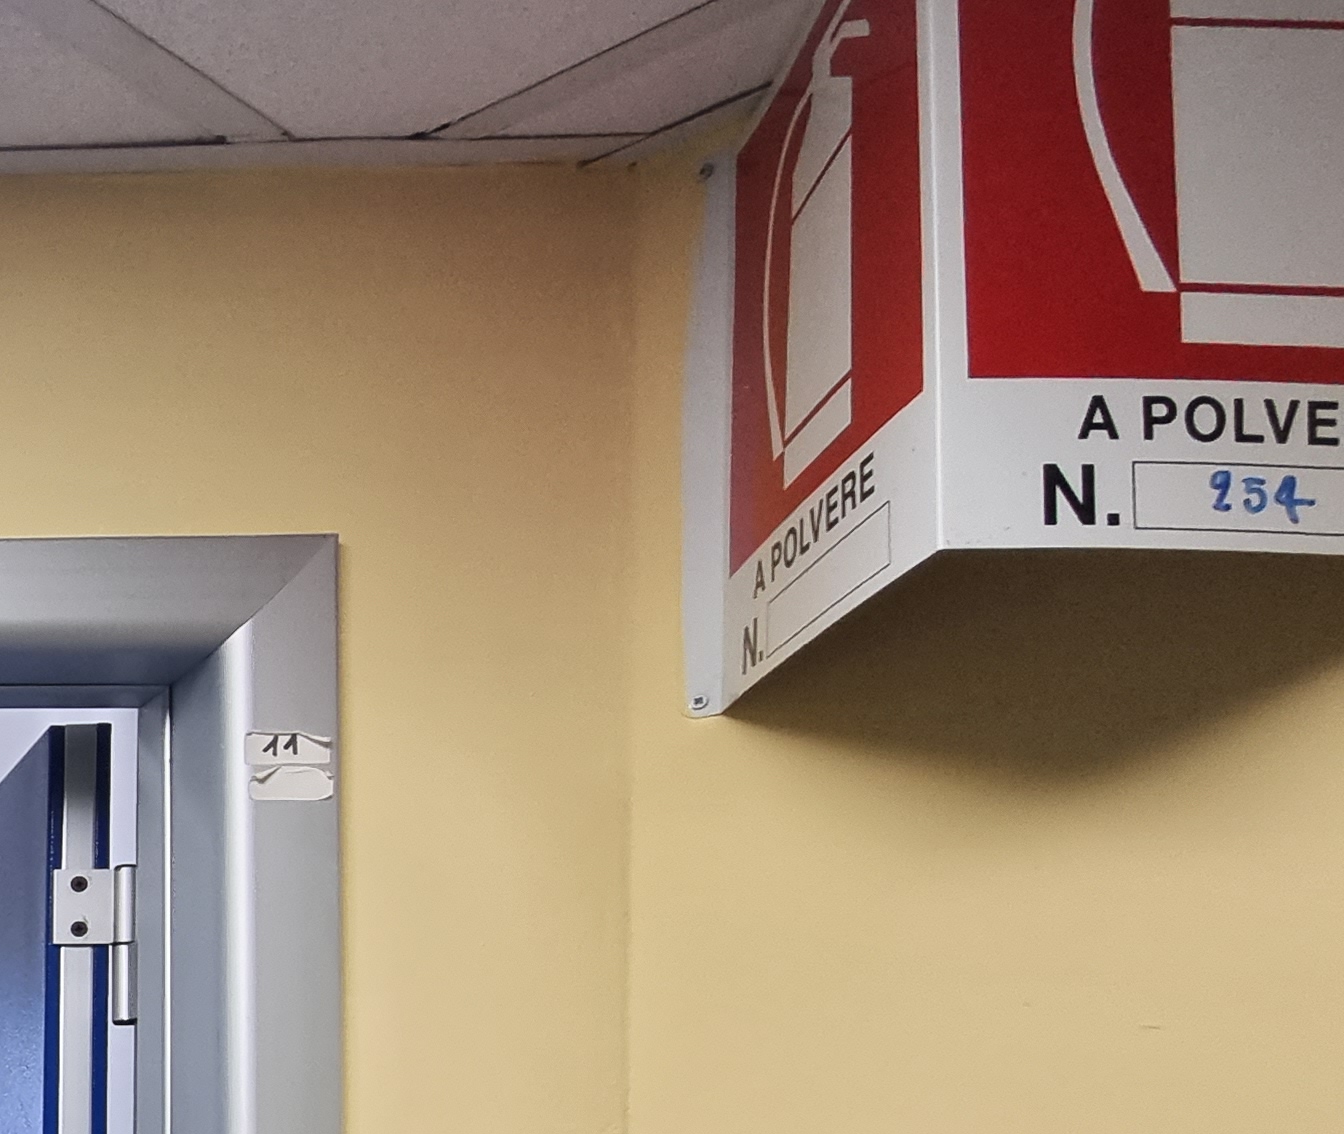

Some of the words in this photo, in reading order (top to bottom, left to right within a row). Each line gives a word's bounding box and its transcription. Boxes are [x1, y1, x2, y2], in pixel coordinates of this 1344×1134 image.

[1077, 394, 1120, 440] A
[1141, 394, 1340, 447] POLVE
[1042, 463, 1120, 527] N.
[1209, 469, 1316, 525] 254
[753, 560, 766, 600] A
[770, 450, 876, 583] POLVERE
[741, 617, 764, 676] N.
